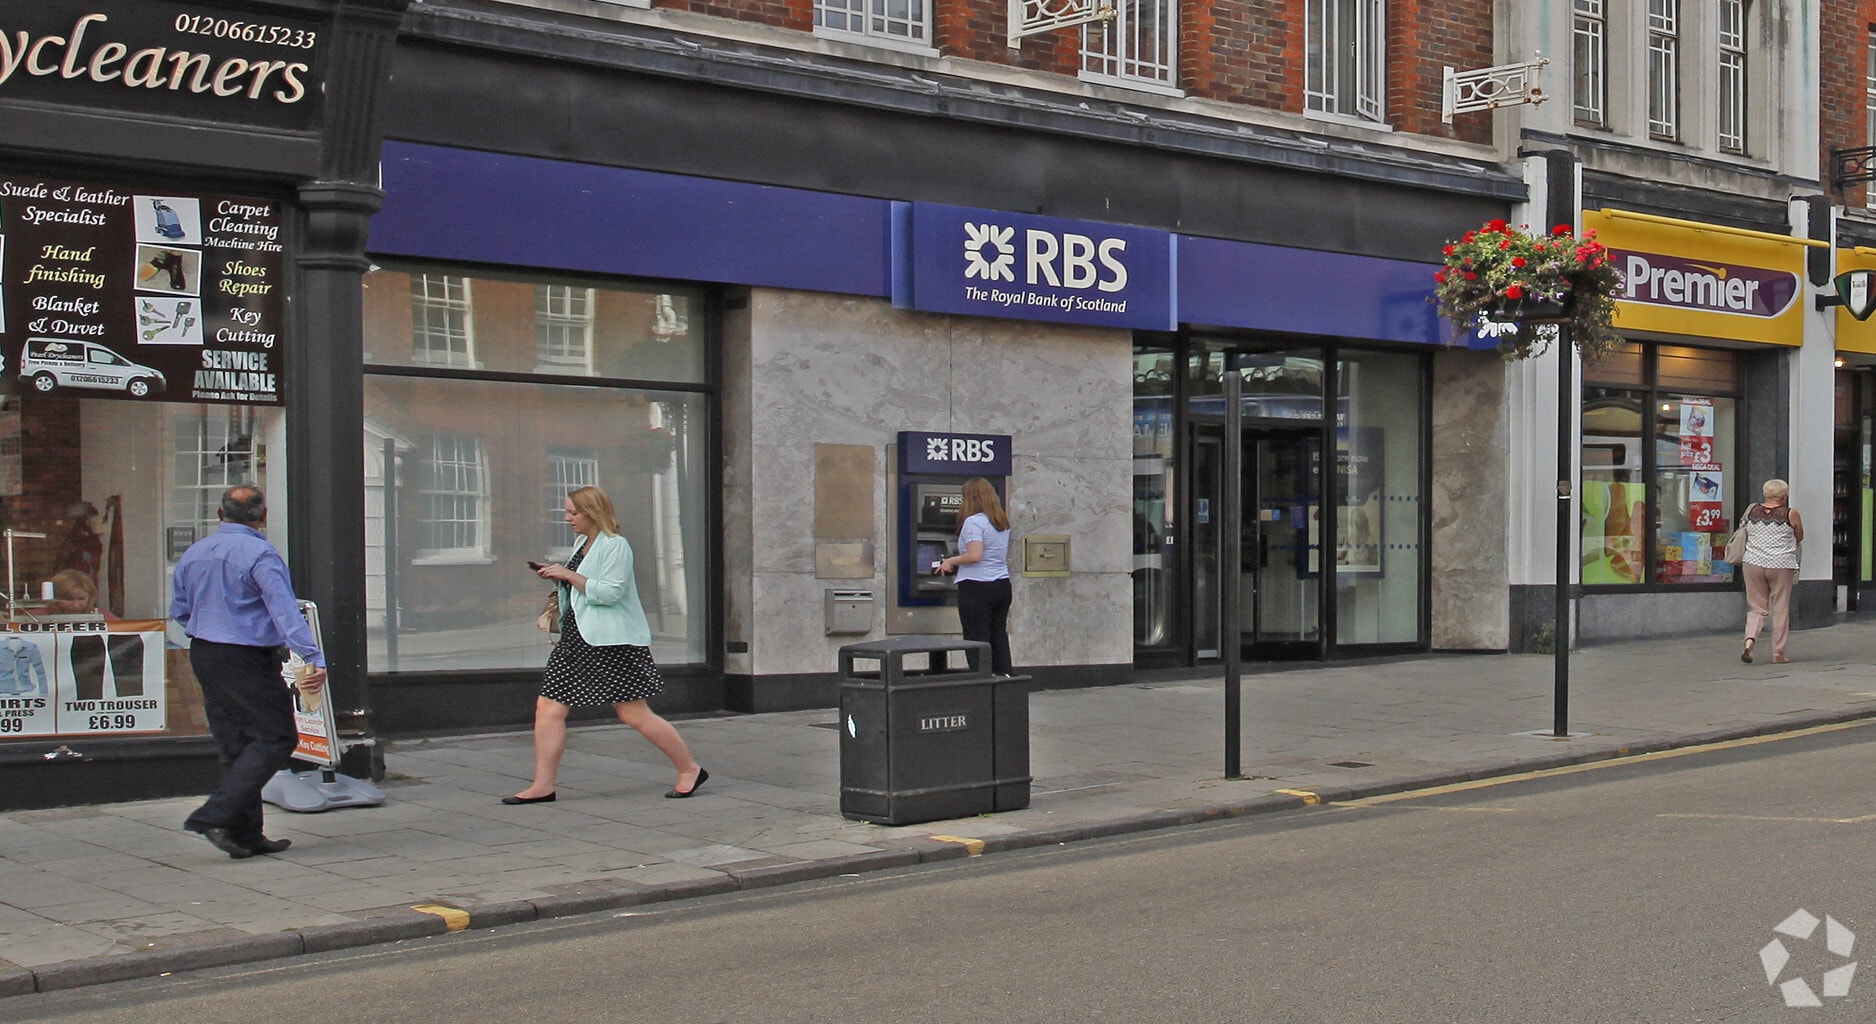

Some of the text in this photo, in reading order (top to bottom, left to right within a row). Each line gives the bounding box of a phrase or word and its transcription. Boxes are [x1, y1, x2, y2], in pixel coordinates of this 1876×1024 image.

[175, 13, 317, 49] 01206615233
[0, 182, 130, 206] Suede & leather
[22, 206, 106, 225] Specialist
[217, 200, 271, 220] Carpet
[209, 217, 279, 240] Cleaning
[41, 245, 96, 262] Hand
[204, 236, 283, 252] Machine Hire
[222, 260, 267, 277] Shoes
[1026, 228, 1129, 293] RBS
[23, 264, 106, 289] finishing
[1626, 254, 1759, 311] Premier
[219, 279, 272, 297] Repair
[32, 296, 100, 317] Blanket
[965, 286, 1127, 313] The Royal Bank of Scotland
[230, 307, 261, 326] Key
[28, 317, 105, 336] & Duvet
[216, 328, 276, 349] Cutting
[202, 349, 268, 372] SERVICE
[194, 370, 276, 393] AVAILABLE
[236, 392, 249, 401] for
[952, 439, 995, 462] RBS
[1694, 442, 1711, 464] £3
[1696, 509, 1721, 526] £3.99
[19, 622, 108, 634] OFFER
[5, 709, 35, 717] PRESS
[65, 699, 158, 712] TWO TROUSER
[88, 714, 136, 730] £6.99
[921, 715, 967, 731] LITTER
